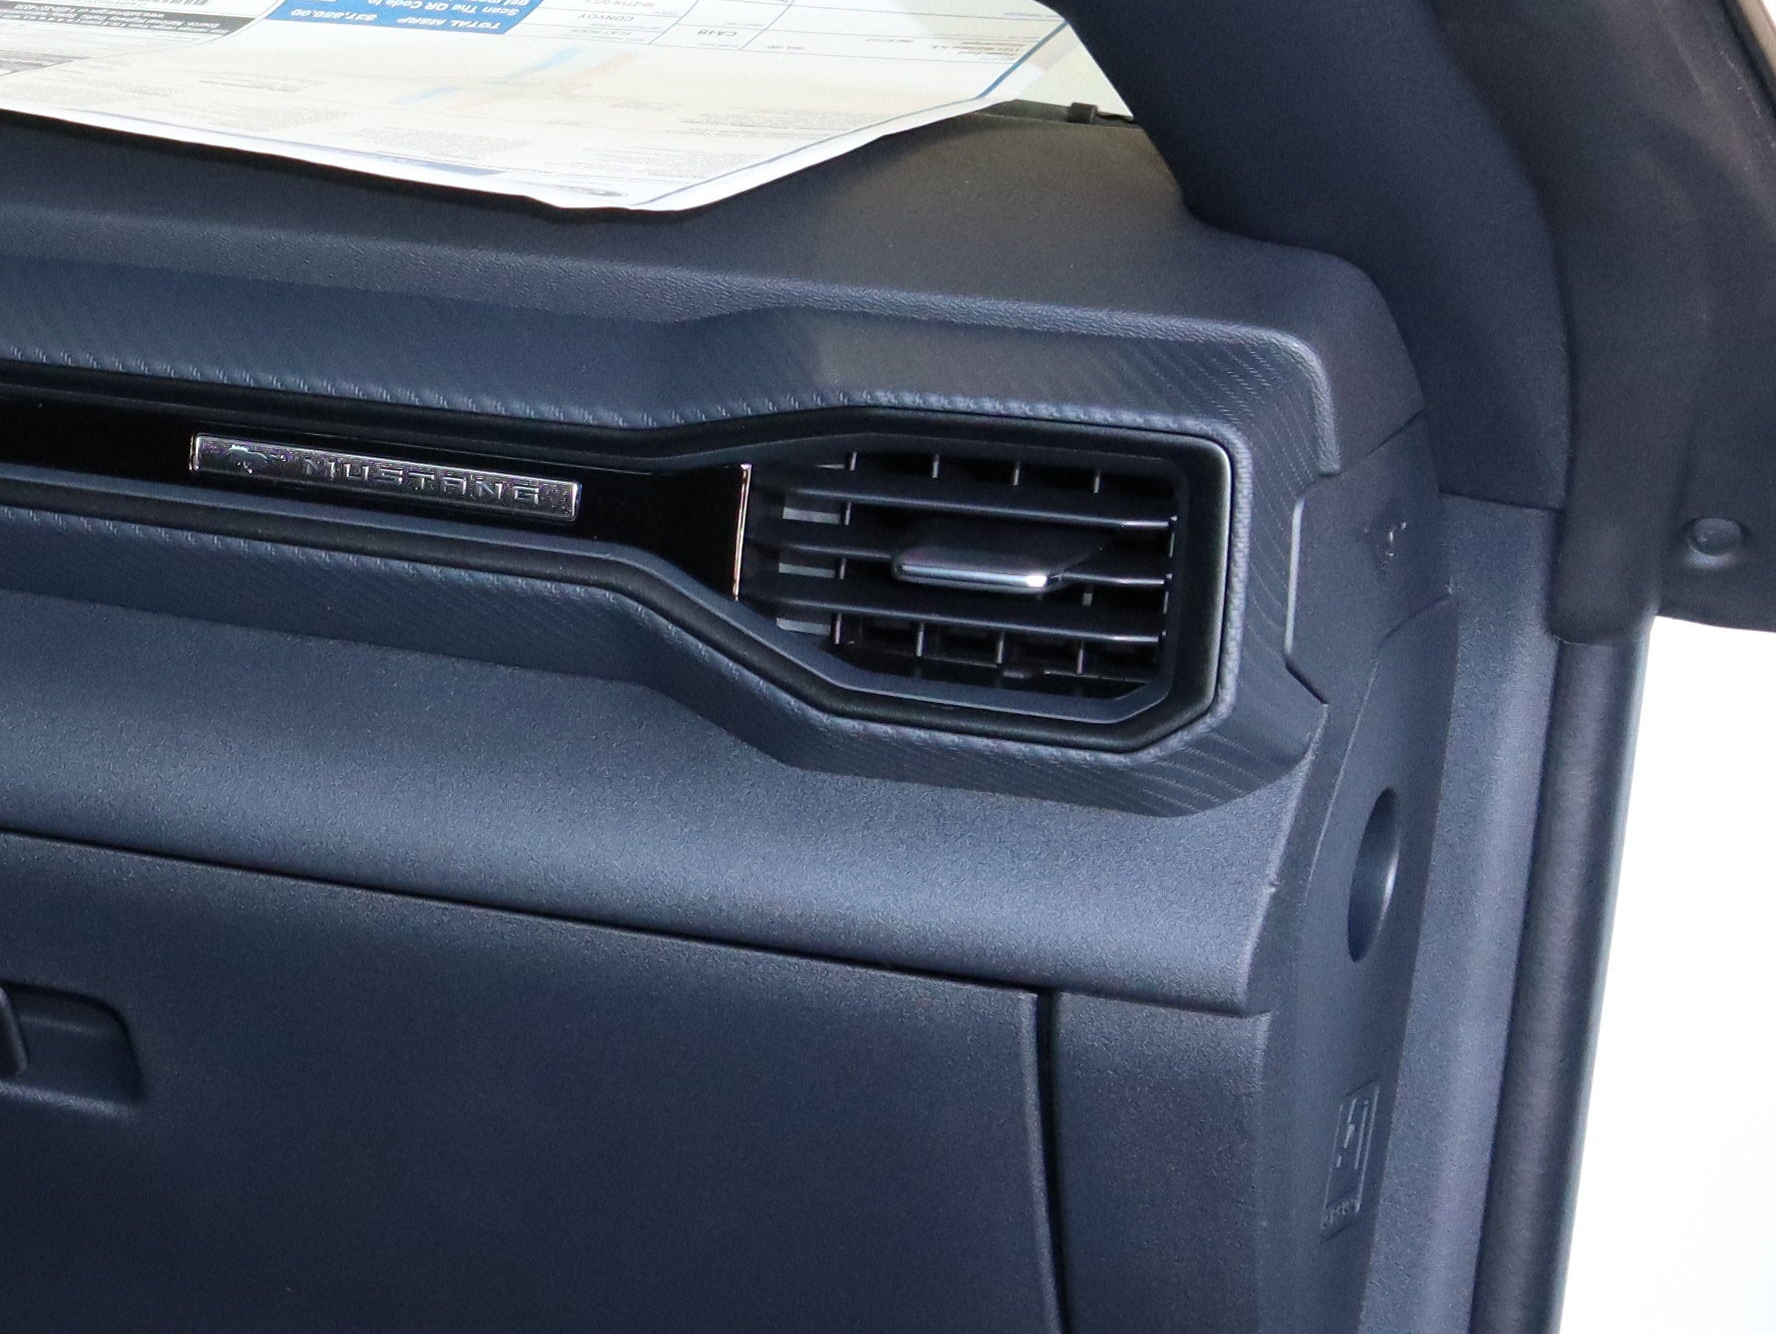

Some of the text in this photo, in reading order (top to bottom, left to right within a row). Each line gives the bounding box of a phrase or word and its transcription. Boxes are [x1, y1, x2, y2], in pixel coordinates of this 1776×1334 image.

[423, 0, 451, 10] QR
[448, 4, 482, 13] The
[478, 6, 521, 16] Scan
[395, 16, 447, 25] MSRP
[575, 12, 635, 22] CONVOY
[446, 19, 503, 28] TOTAL
[304, 457, 541, 506] MUSTANG
